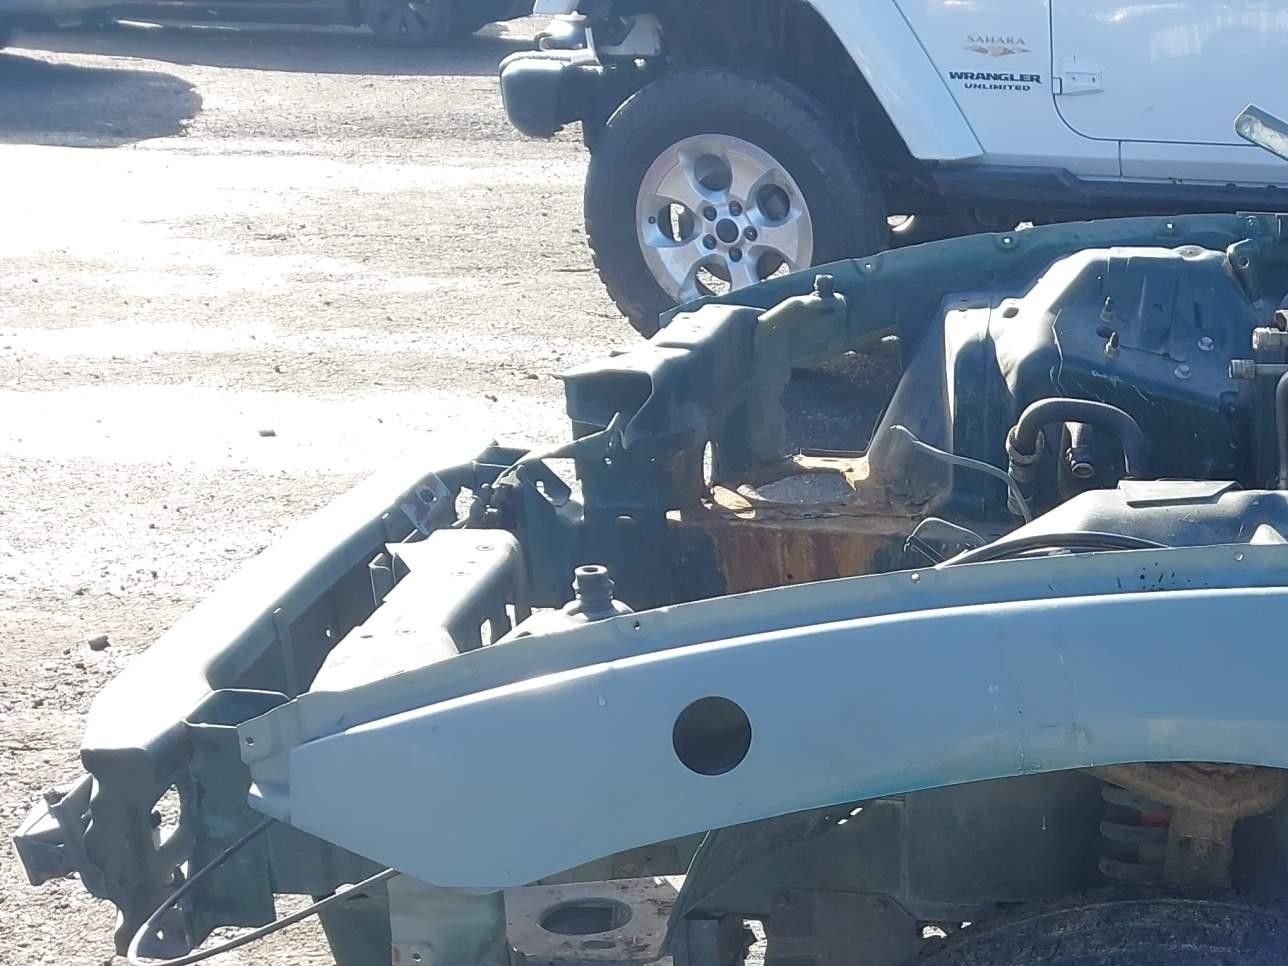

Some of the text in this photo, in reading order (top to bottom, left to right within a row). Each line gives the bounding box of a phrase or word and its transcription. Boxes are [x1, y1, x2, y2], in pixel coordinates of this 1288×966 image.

[967, 35, 1026, 45] SAHARA
[949, 71, 1042, 84] WRANGLER
[964, 83, 1031, 92] UNLIMITED
